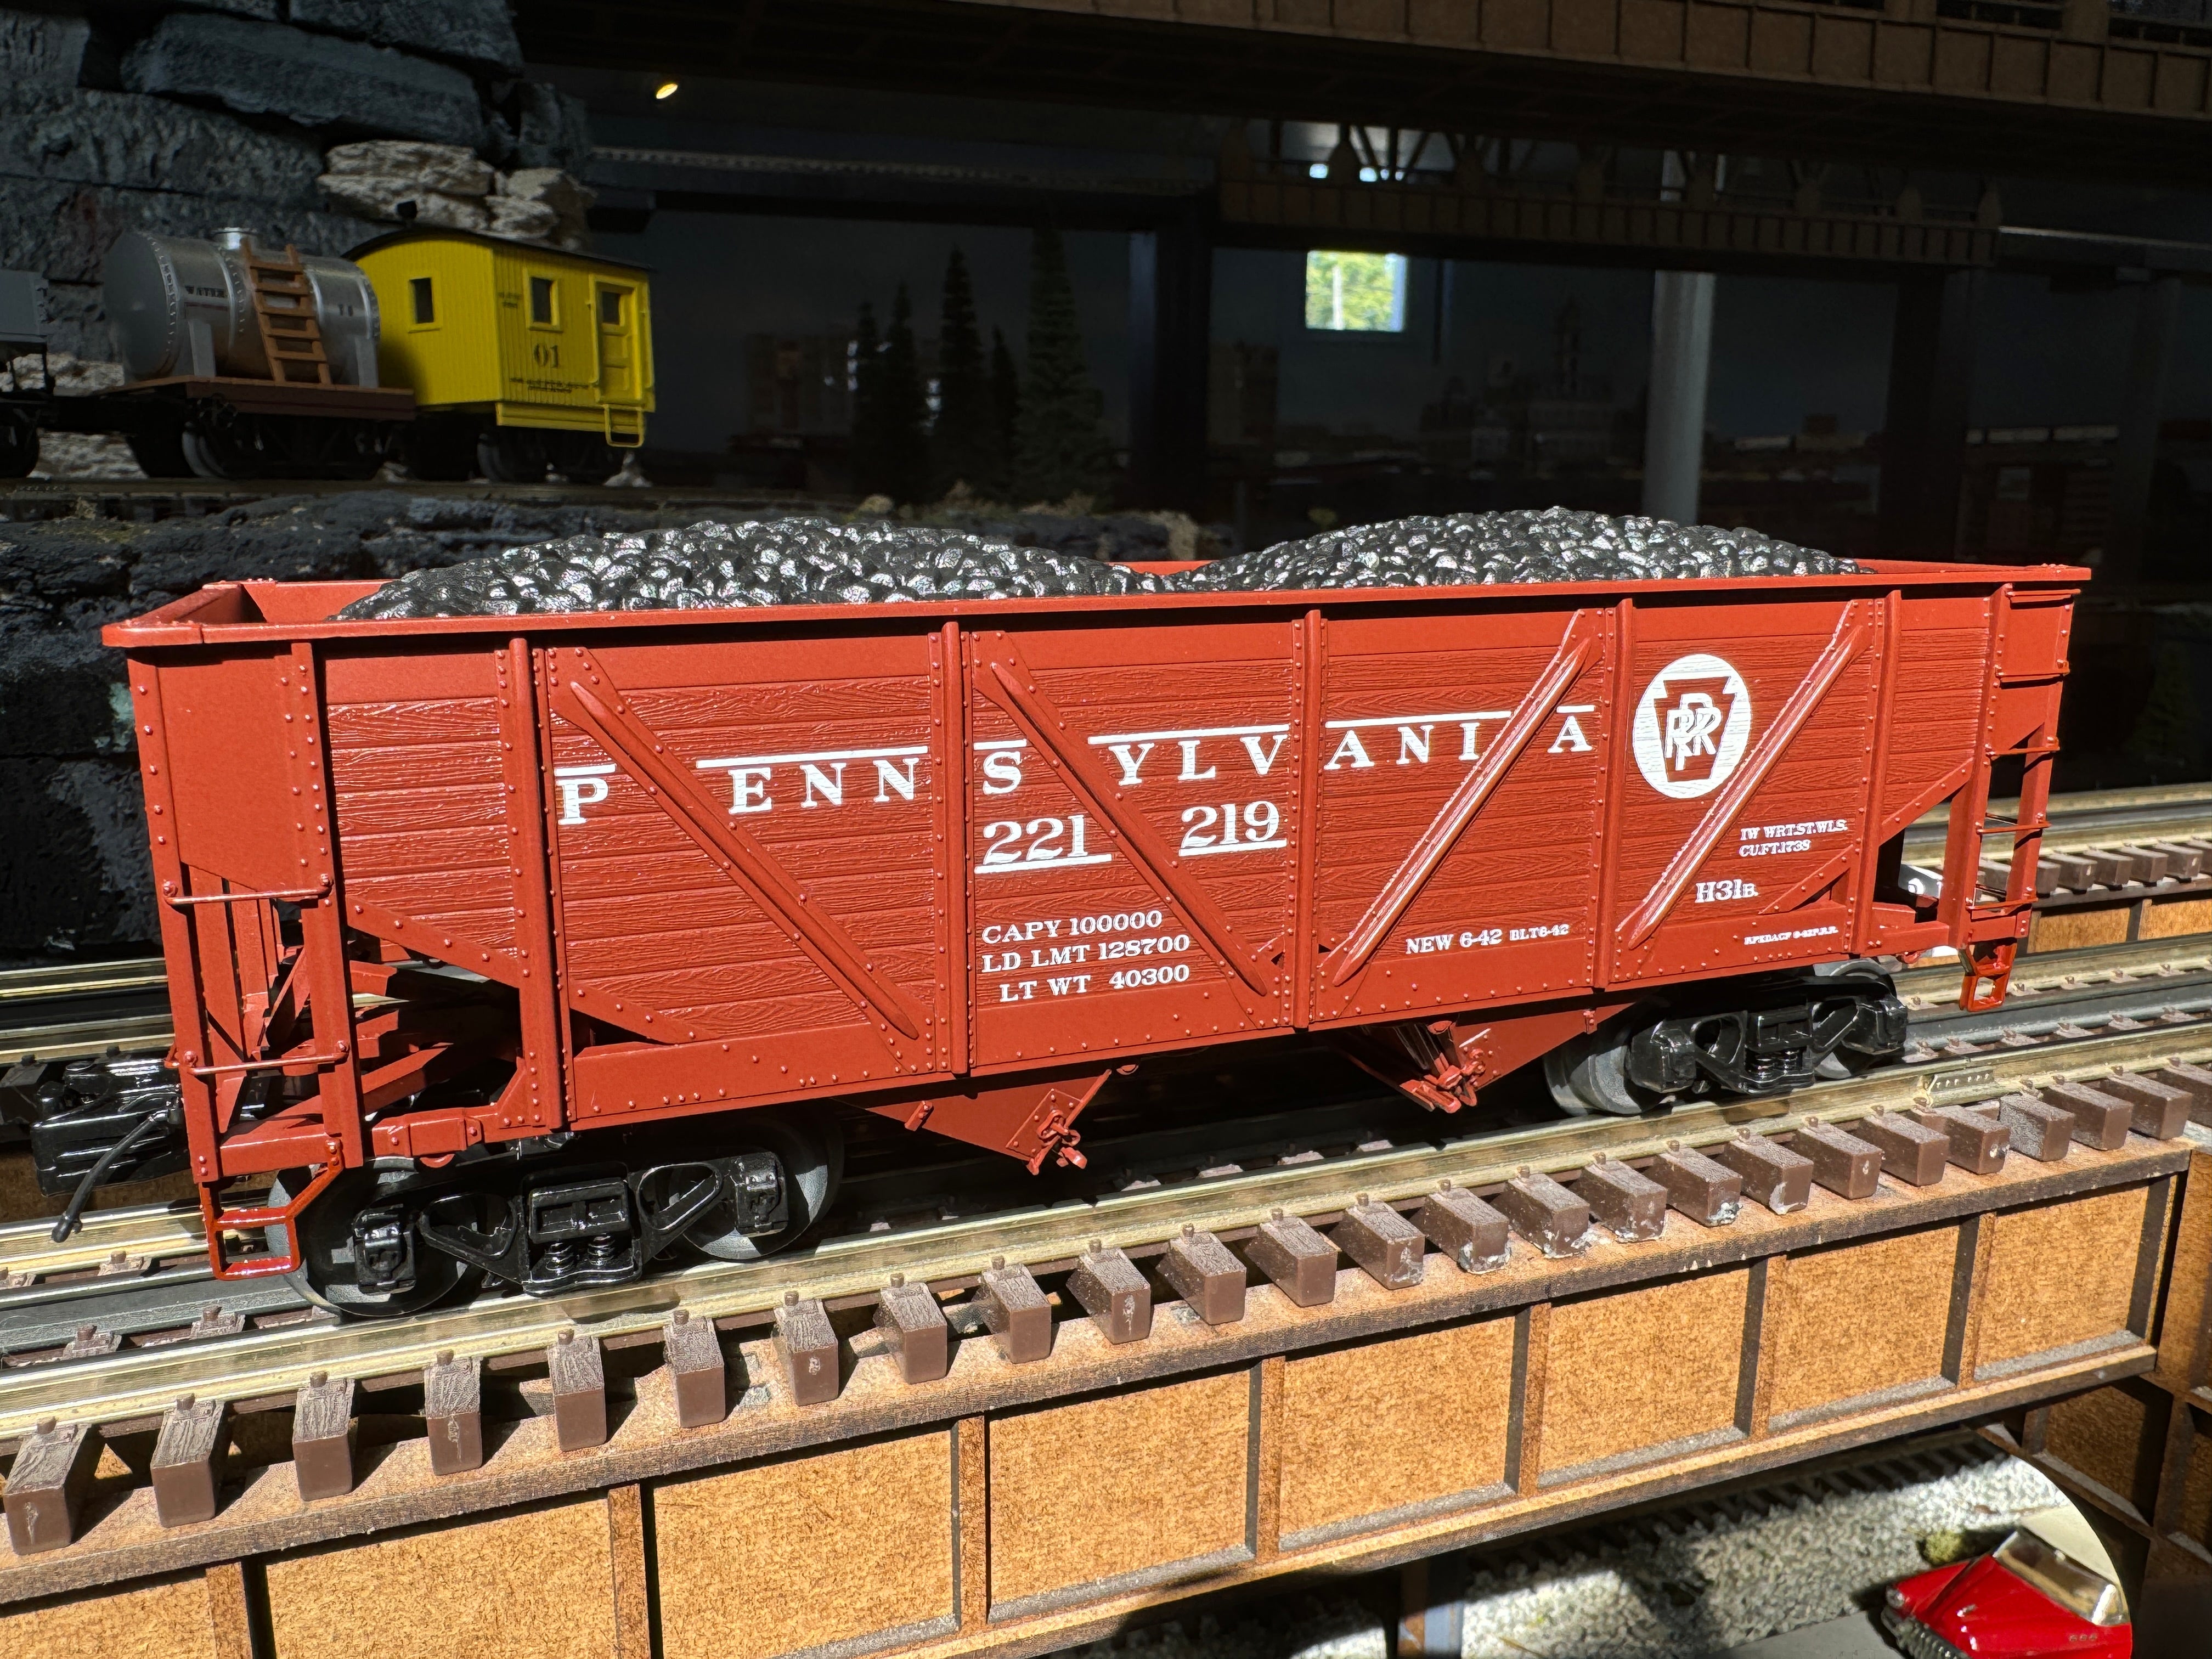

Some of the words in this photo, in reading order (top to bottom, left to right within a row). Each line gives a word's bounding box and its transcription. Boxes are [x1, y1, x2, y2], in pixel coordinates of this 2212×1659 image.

[533, 342, 558, 368] 01
[981, 918, 1062, 944] CAPY
[1069, 910, 1163, 935] 100000
[1406, 934, 1454, 954] NEW
[1459, 929, 1502, 947] 6-42
[981, 952, 1021, 973] LD
[1031, 945, 1090, 967] LMT
[1098, 934, 1190, 960] 128700
[1000, 980, 1037, 1002] LT
[1047, 975, 1091, 996] WT
[1109, 964, 1189, 989] 40300
